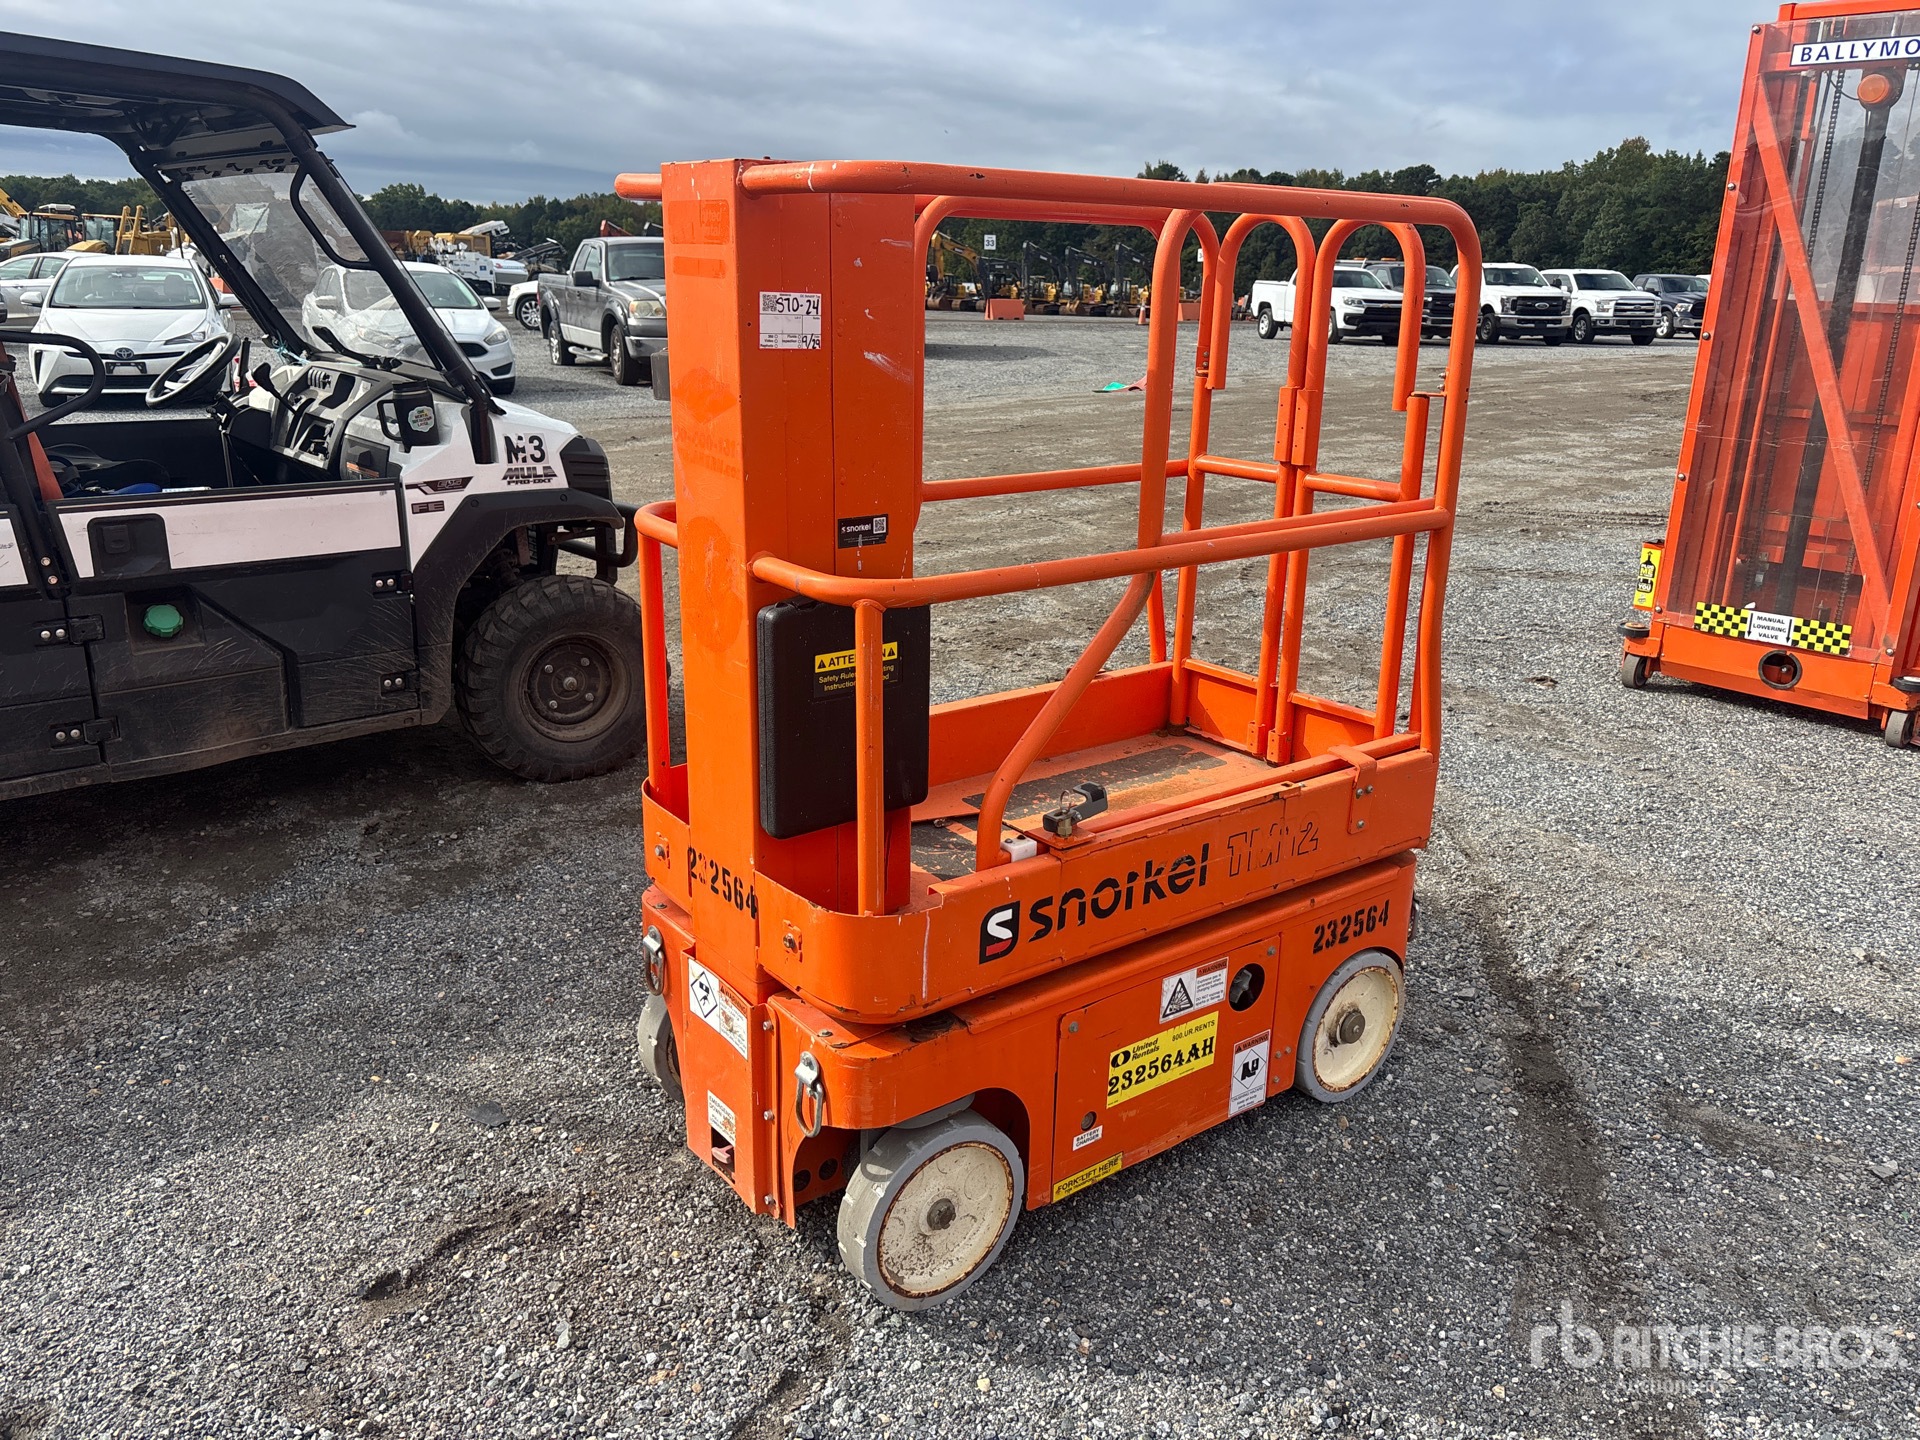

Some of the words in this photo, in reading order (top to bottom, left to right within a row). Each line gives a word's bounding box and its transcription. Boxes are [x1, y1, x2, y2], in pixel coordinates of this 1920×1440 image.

[1800, 38, 1920, 62] BALLYMO
[985, 238, 995, 247] 33
[501, 466, 558, 480] MULE
[412, 502, 443, 513] FE
[846, 524, 871, 533] snorkel
[1756, 615, 1785, 625] MANUAL
[1752, 623, 1787, 633] LOWERING
[1758, 632, 1779, 641] VALVE
[828, 648, 886, 667] ATTEN
[819, 675, 839, 684] Safety
[840, 671, 856, 679] Rule
[1028, 843, 1209, 943] snorkel
[1312, 899, 1390, 954] 232564
[1132, 1037, 1159, 1053] United
[1131, 1045, 1160, 1061] Rentals
[1107, 1036, 1215, 1097] 232564AH
[1075, 1133, 1099, 1147] CHARGER
[1076, 1128, 1100, 1142] BATTERY
[1056, 1168, 1097, 1192] FORK-LIFT
[1098, 1157, 1120, 1172] HERE
